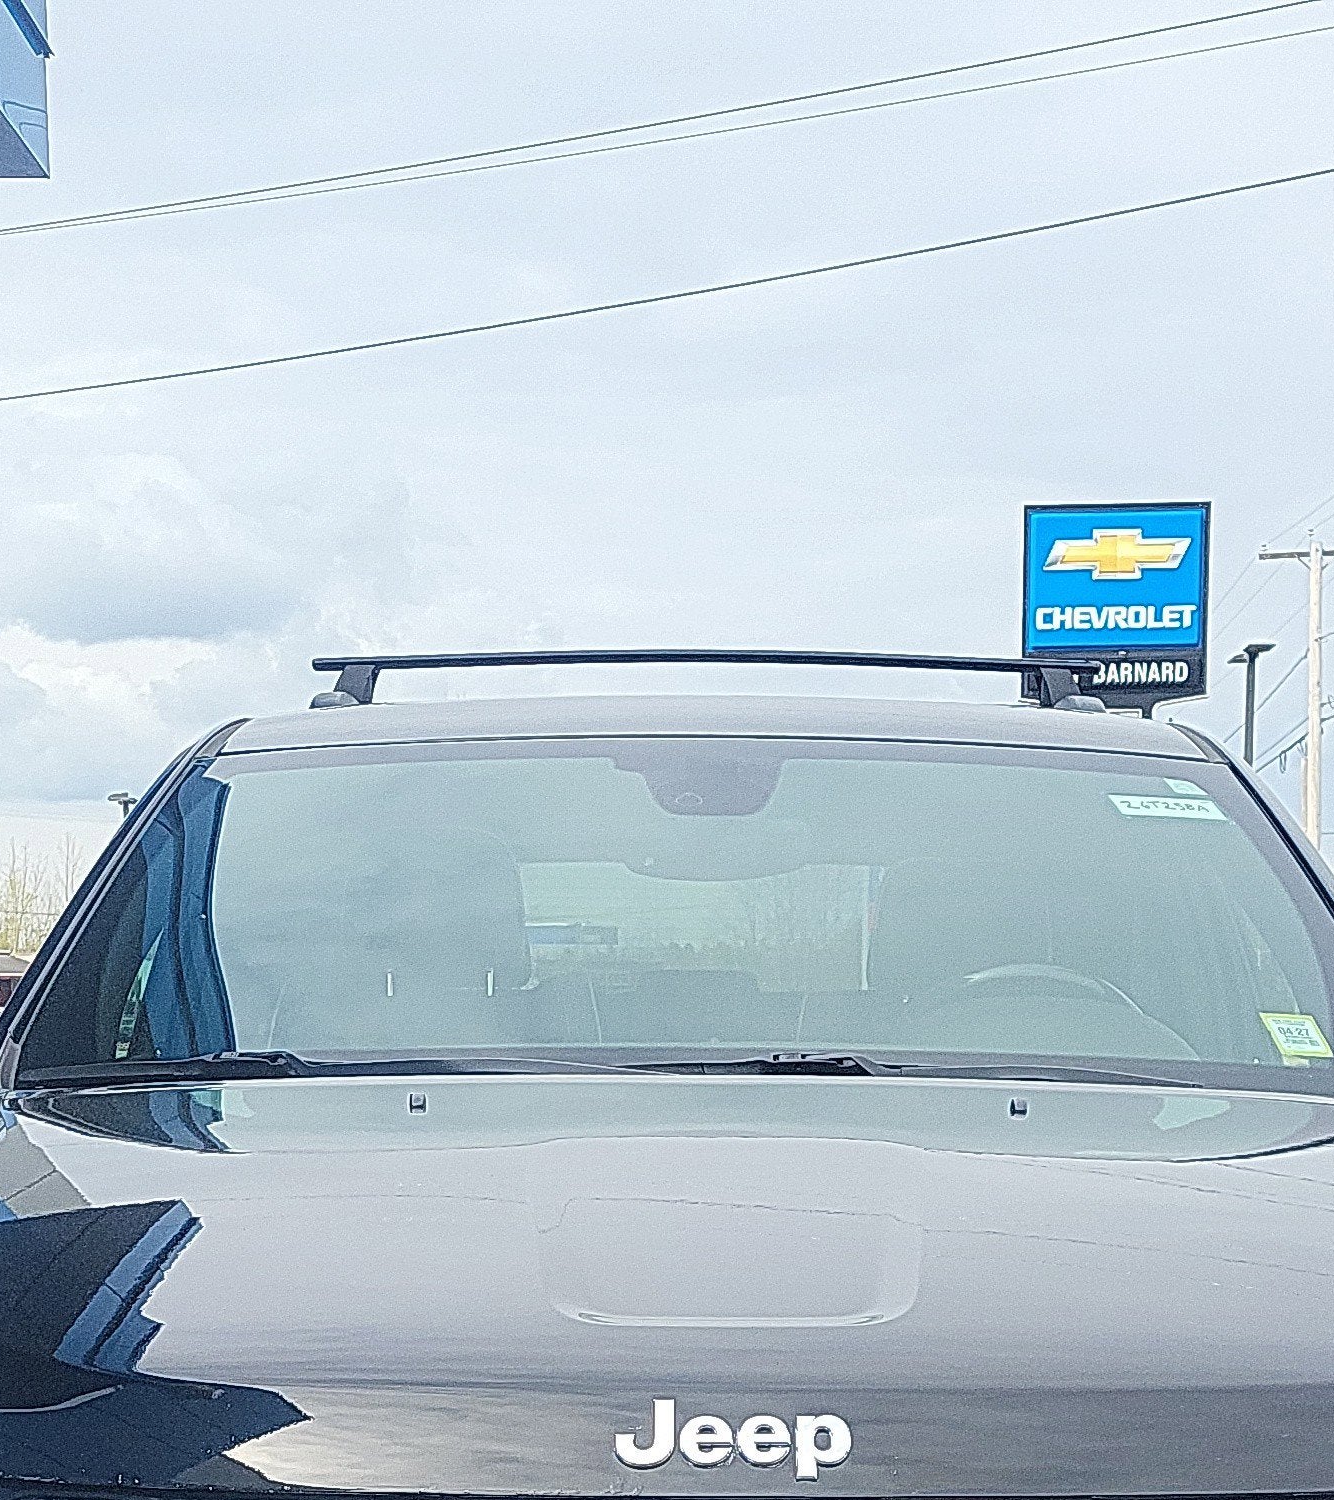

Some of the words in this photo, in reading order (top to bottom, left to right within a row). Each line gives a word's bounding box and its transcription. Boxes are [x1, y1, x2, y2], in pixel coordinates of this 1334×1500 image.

[1035, 604, 1198, 631] CHEVROLET
[1093, 661, 1189, 685] BARNARD
[614, 1398, 853, 1482] Jeep
